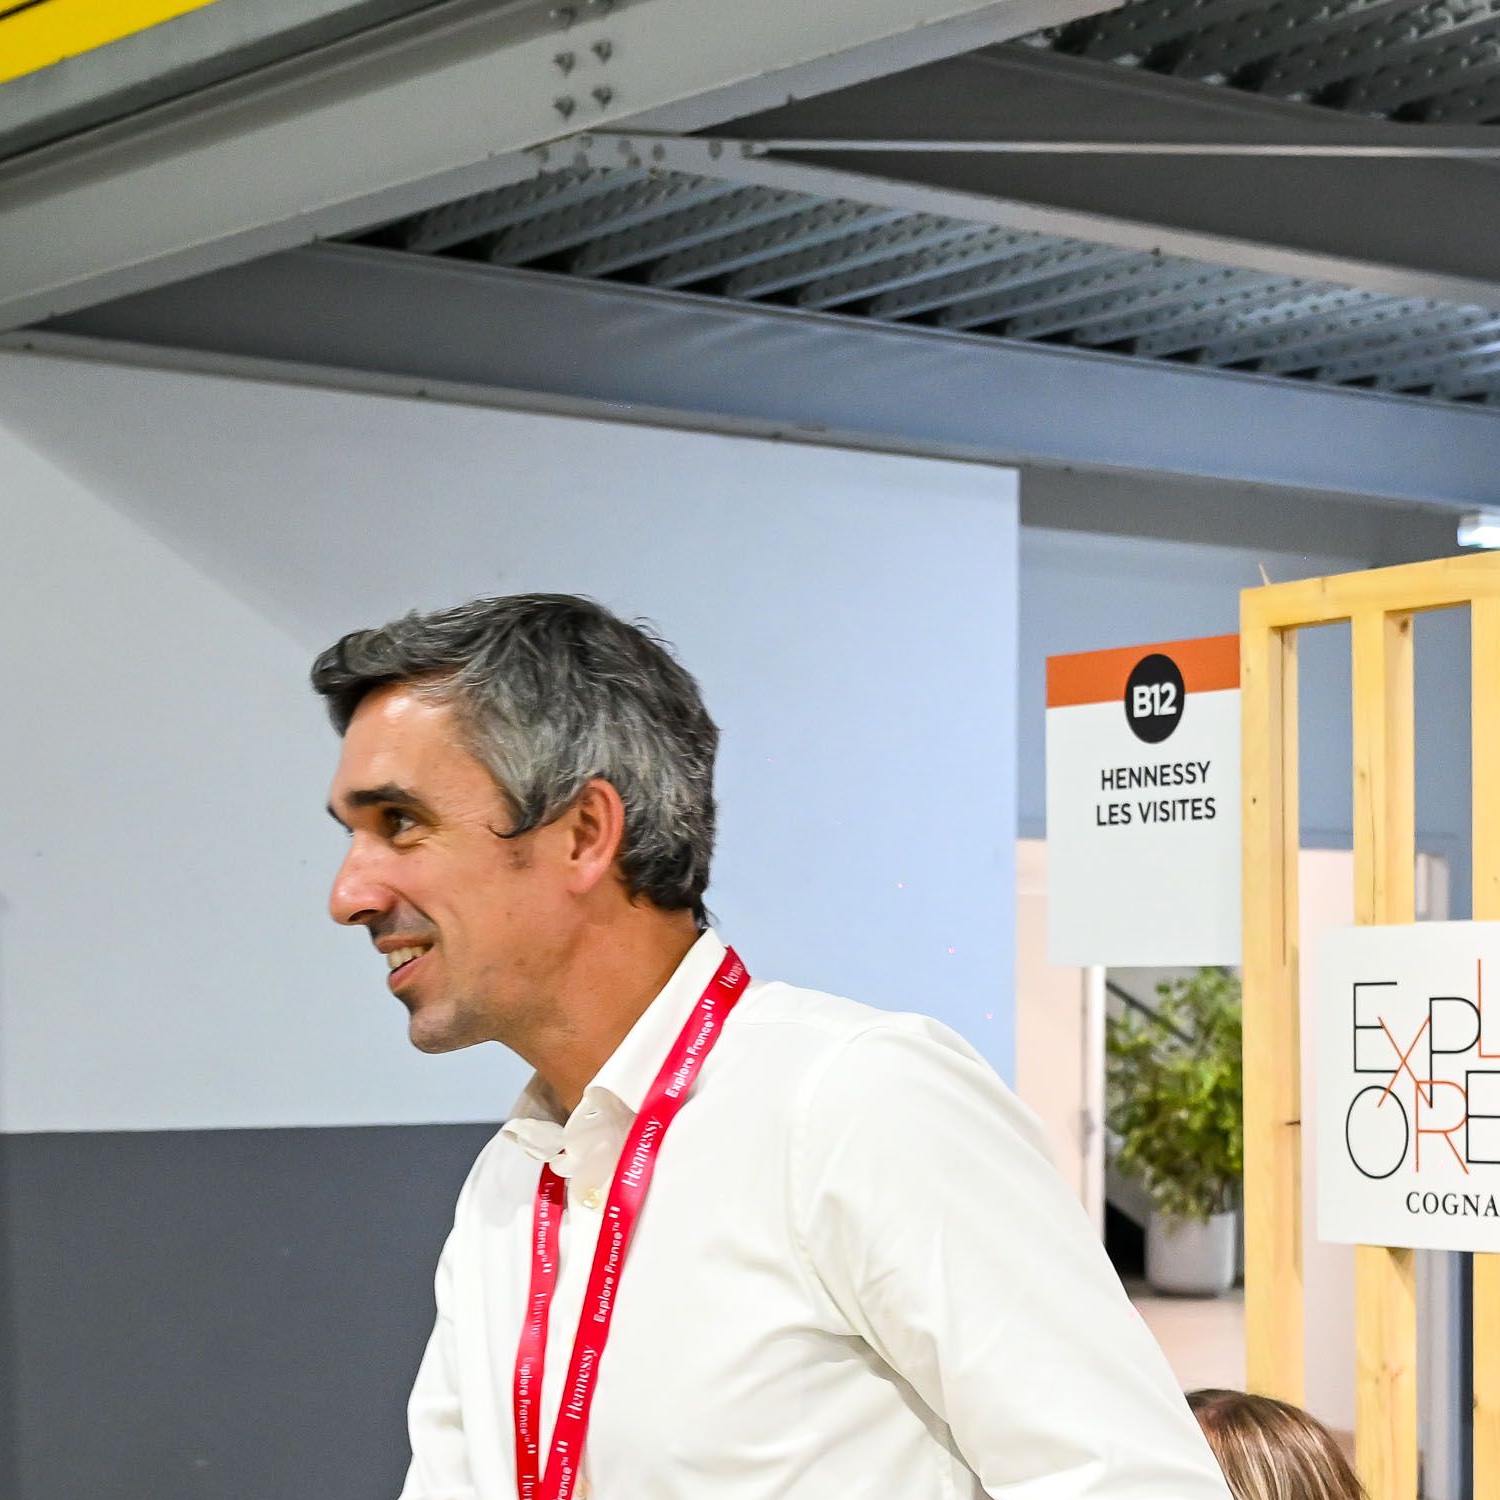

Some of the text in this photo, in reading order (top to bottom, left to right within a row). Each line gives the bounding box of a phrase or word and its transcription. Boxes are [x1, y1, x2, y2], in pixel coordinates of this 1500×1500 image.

[1133, 682, 1177, 718] B12
[1100, 760, 1212, 792] HENNESSY
[1096, 797, 1217, 827] LES VISITES
[665, 1046, 695, 1099] Explore
[621, 1115, 664, 1188] Hennessy
[593, 1277, 614, 1323] Explore
[565, 1345, 598, 1420] Hennessy
